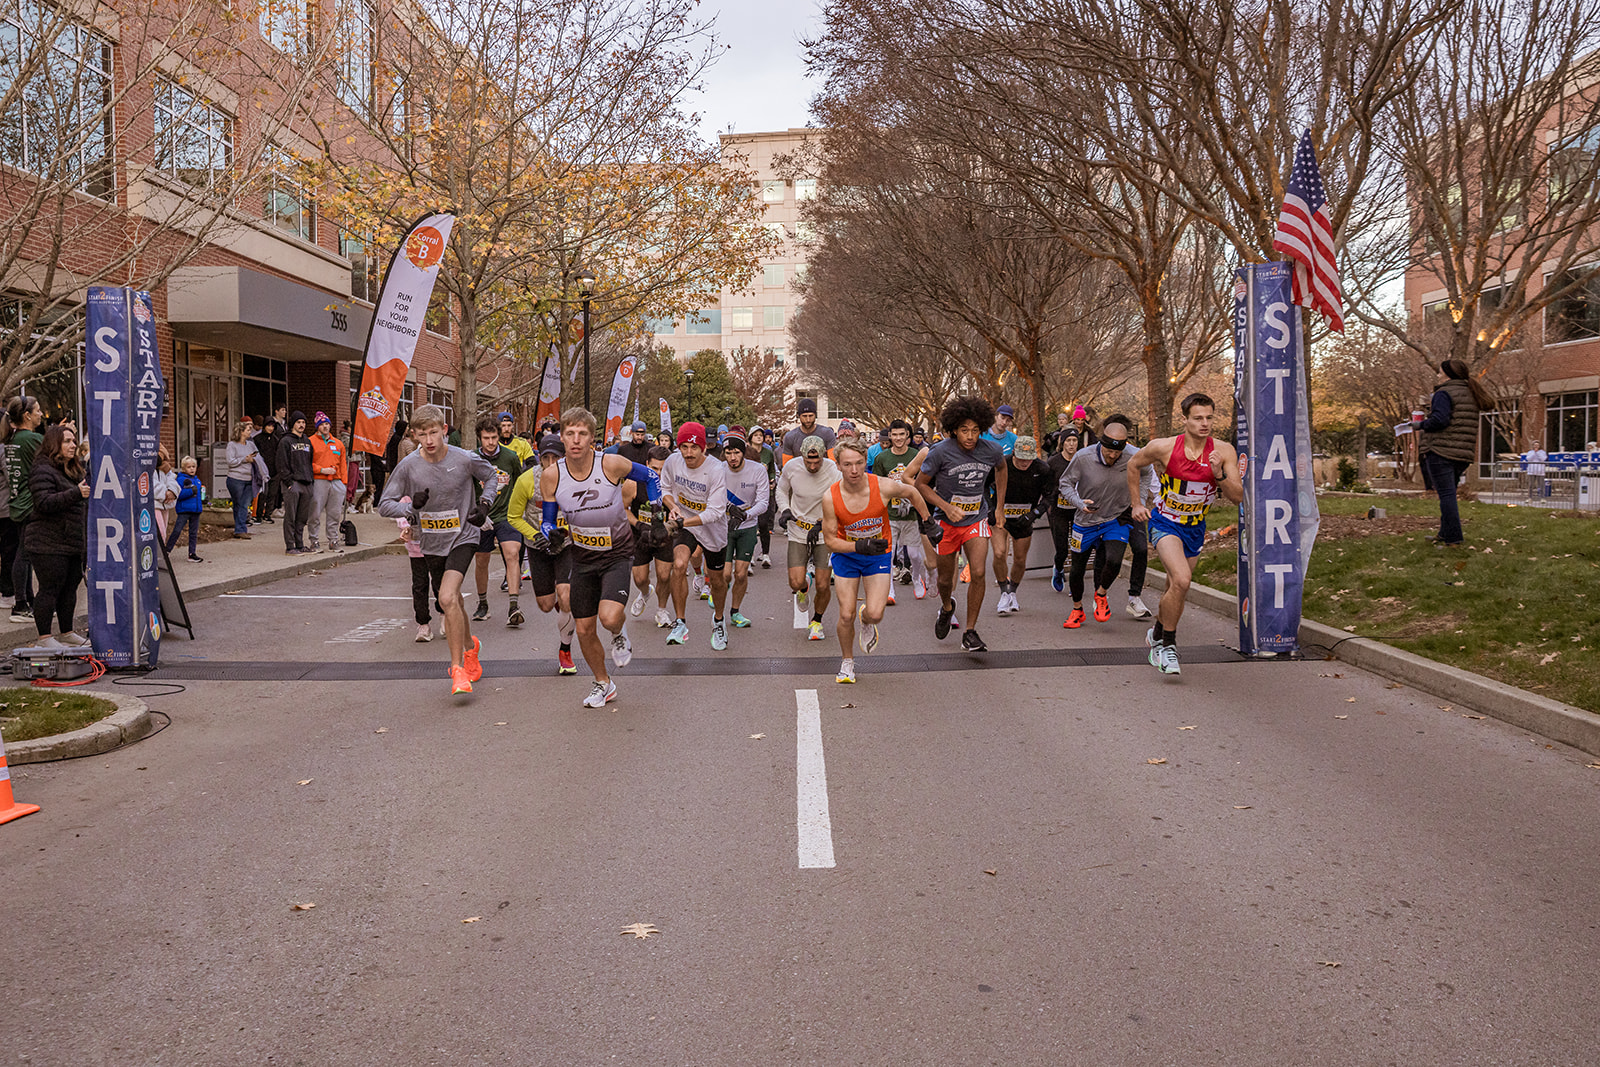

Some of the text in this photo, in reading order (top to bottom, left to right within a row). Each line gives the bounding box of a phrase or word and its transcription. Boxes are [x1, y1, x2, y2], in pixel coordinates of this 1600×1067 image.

[417, 232, 440, 245] Corral
[418, 244, 428, 259] B
[397, 292, 412, 302] RUN
[394, 302, 409, 312] FOR
[330, 311, 348, 332] 2555
[390, 312, 408, 324] YOUR
[376, 318, 416, 338] NEIGHBORS
[137, 328, 160, 429] START
[1262, 302, 1294, 608] START
[94, 326, 125, 624] START
[682, 496, 702, 510] 5399
[1171, 500, 1198, 512] 5427
[428, 519, 453, 529] 5126
[577, 535, 605, 547] 5290
